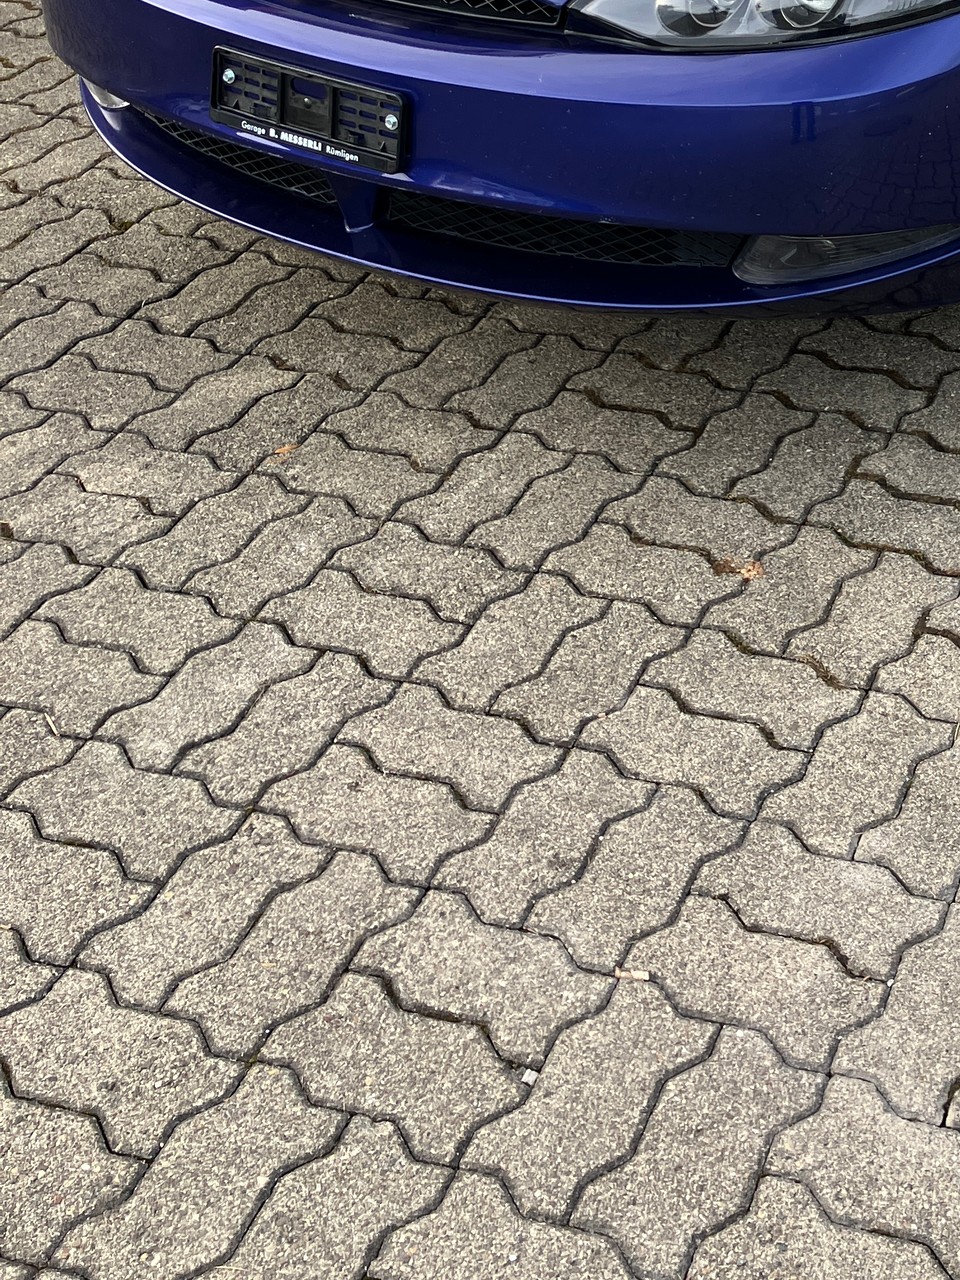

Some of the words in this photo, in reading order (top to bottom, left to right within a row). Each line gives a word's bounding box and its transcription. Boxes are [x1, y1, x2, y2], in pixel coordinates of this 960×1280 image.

[241, 120, 266, 135] Garage
[269, 127, 279, 139] B.
[280, 131, 322, 152] MESSERLI
[325, 145, 359, 162] Rümligen
